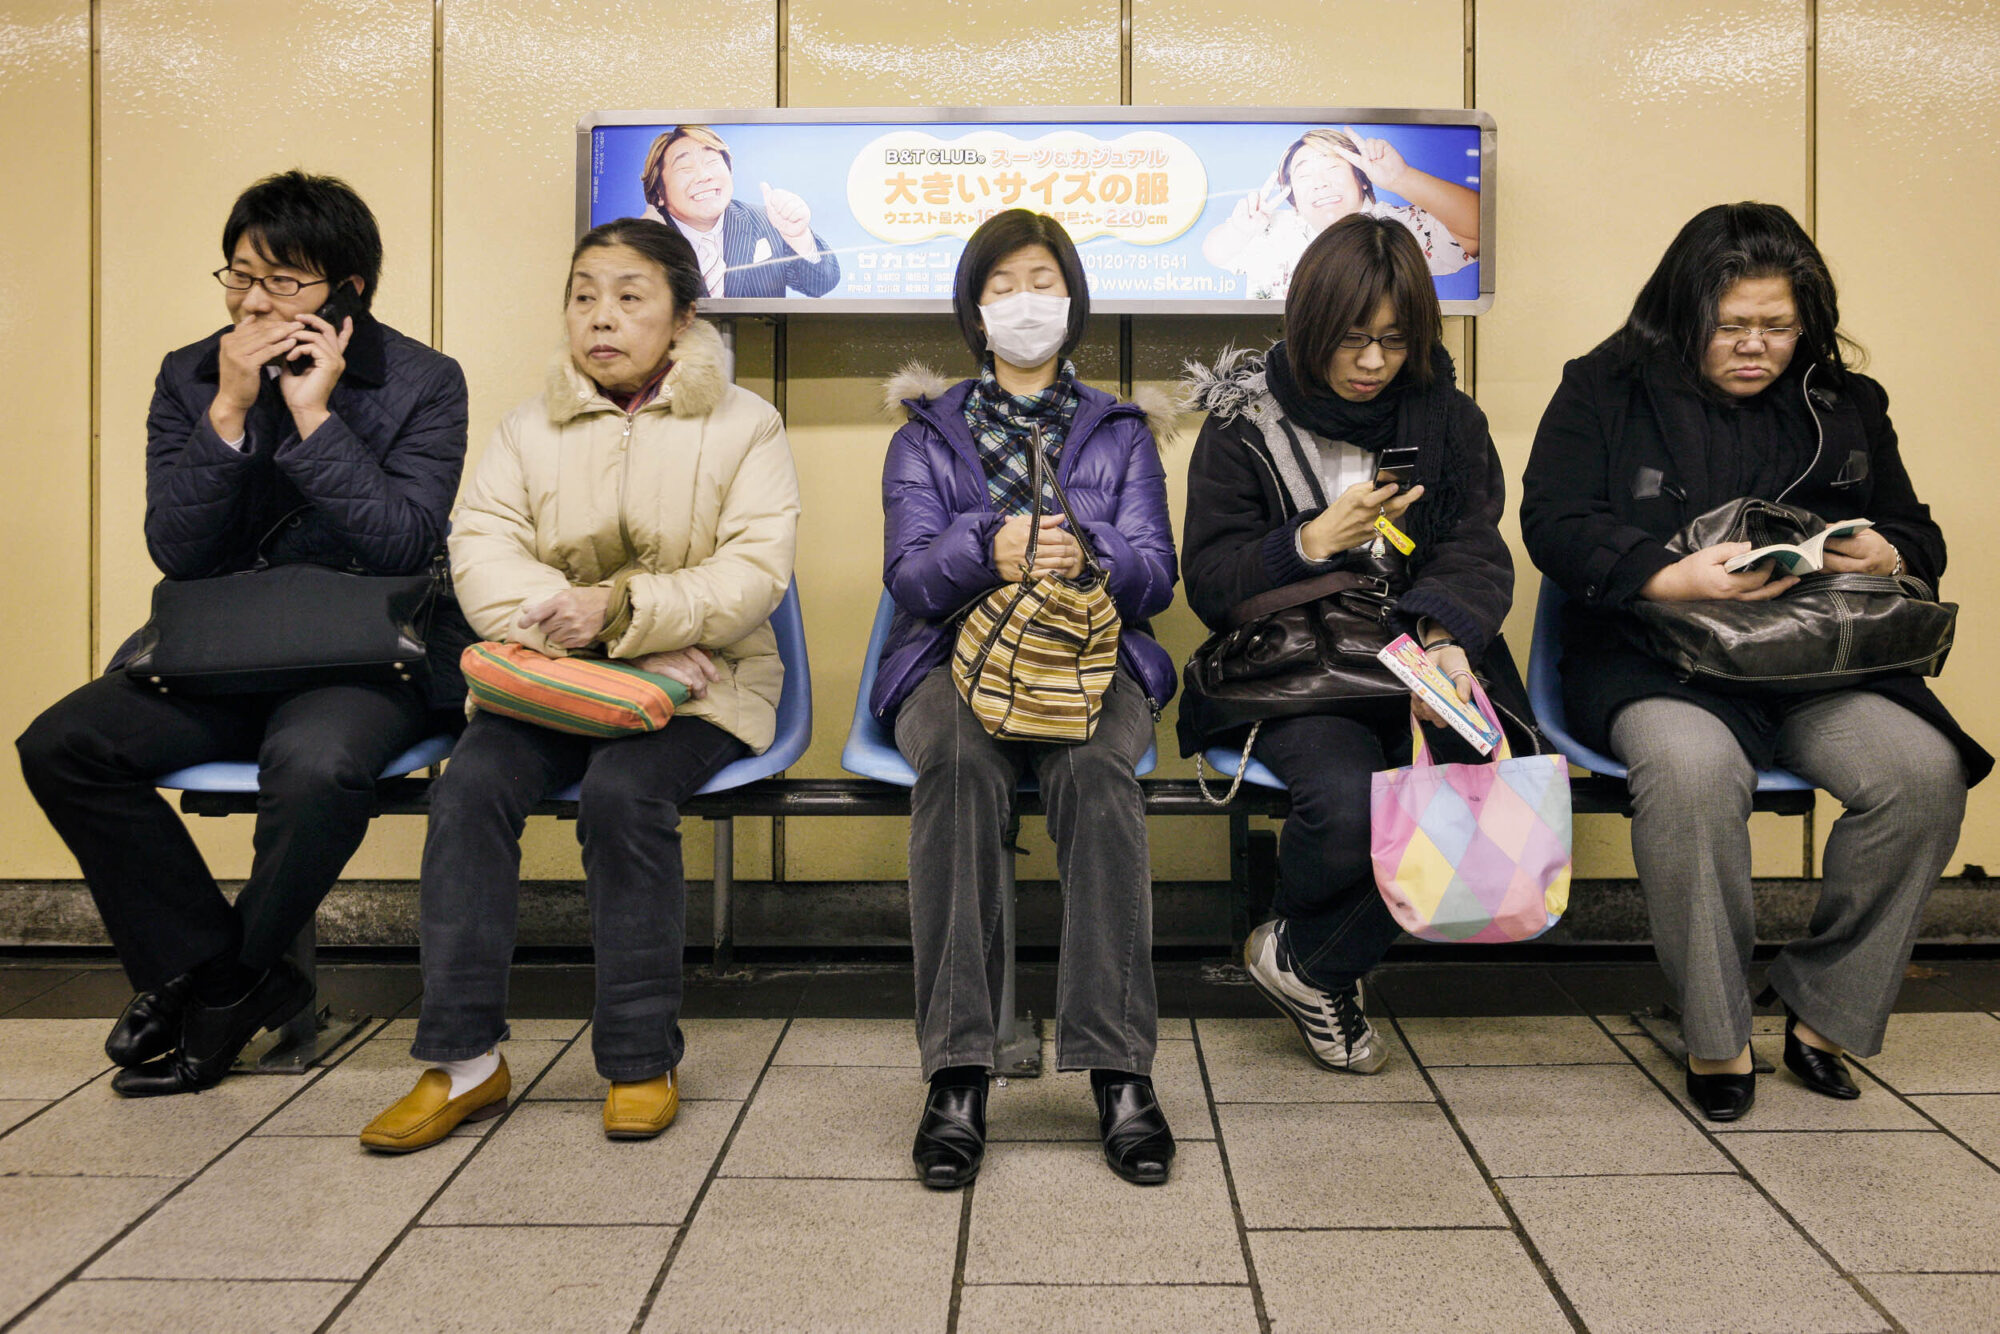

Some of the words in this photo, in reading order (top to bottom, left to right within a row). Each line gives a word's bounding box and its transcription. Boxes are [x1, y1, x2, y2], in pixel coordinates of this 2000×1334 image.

[886, 149, 925, 164] B&T
[884, 171, 1169, 205] 大きいサイズの服
[1106, 208, 1145, 225] 220
[1146, 214, 1168, 225] cm
[1101, 272, 1236, 293] www.skzm.jp
